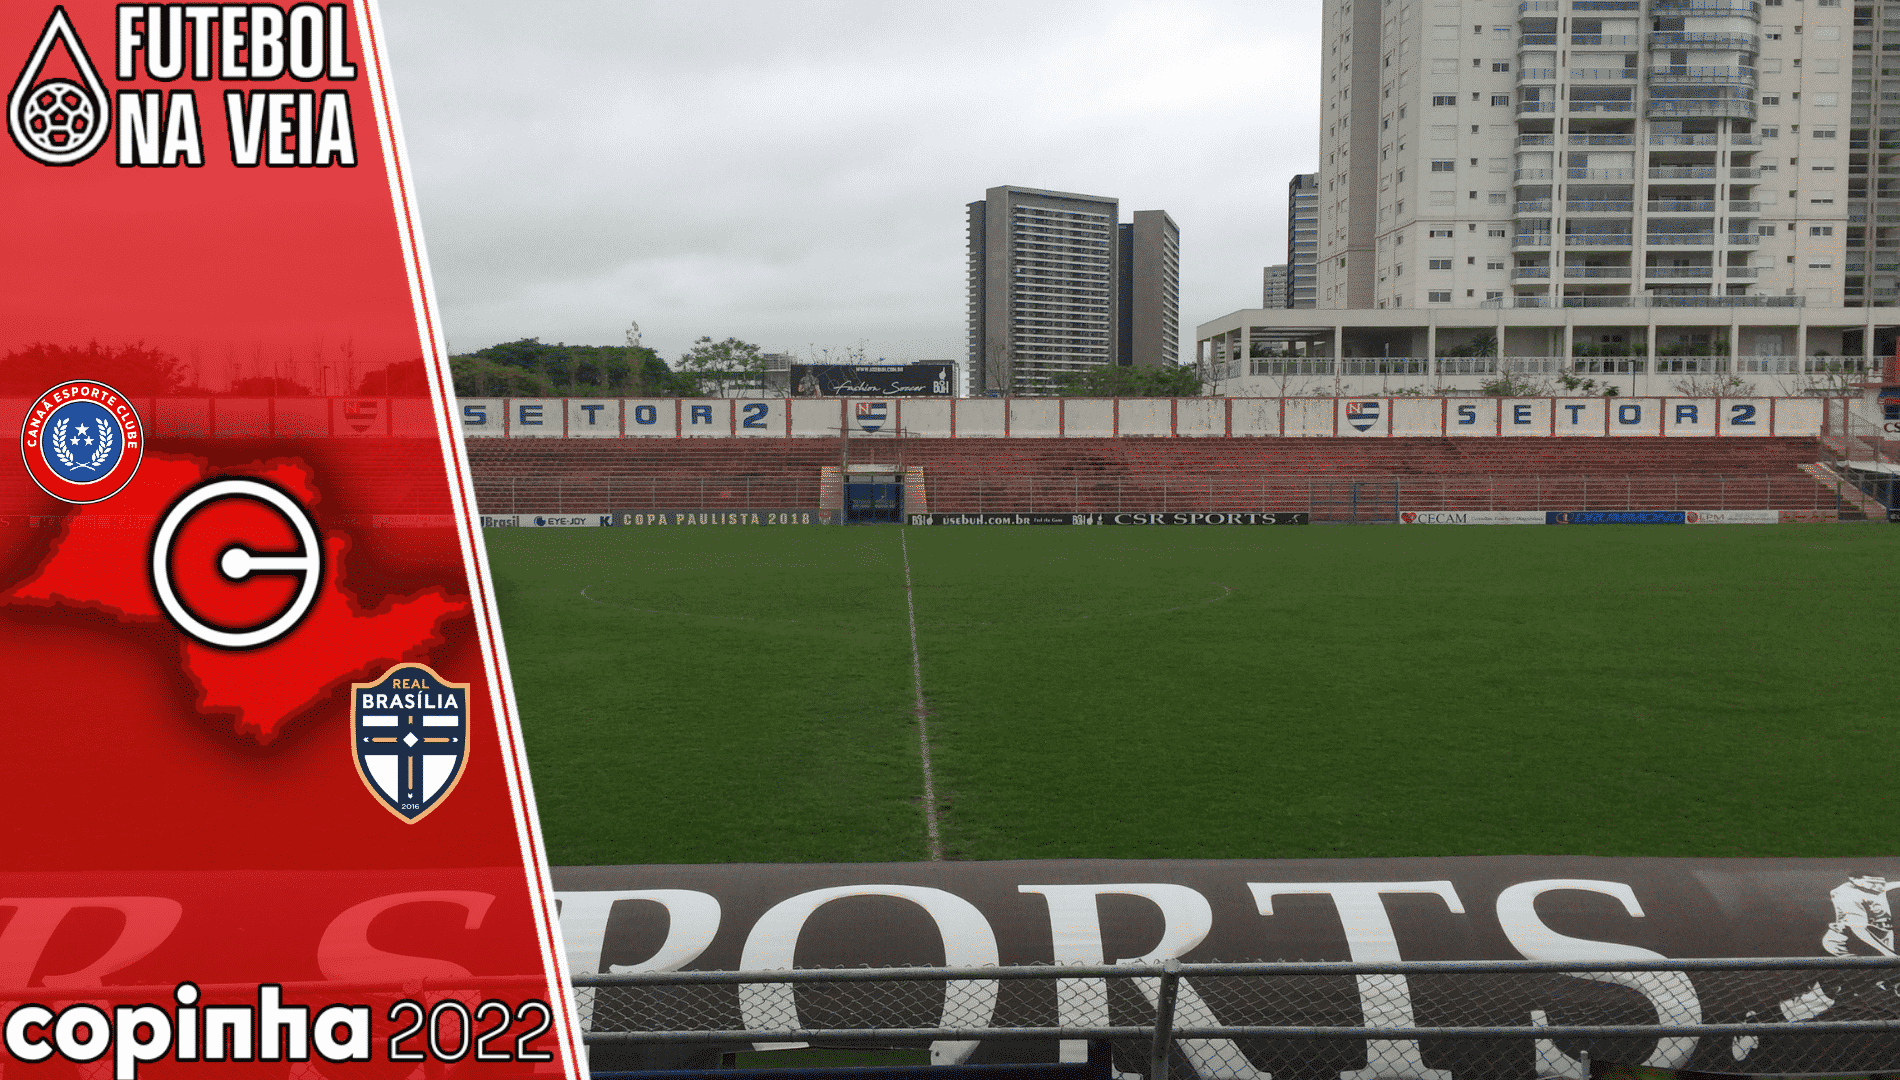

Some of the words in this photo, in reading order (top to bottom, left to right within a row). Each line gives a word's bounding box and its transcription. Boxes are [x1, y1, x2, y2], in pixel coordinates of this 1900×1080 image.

[463, 404, 714, 426] SETOR
[742, 402, 770, 429] 2
[1457, 404, 1699, 425] SETOR
[1730, 404, 1757, 426] 2
[485, 515, 520, 528] Brasil
[547, 517, 587, 525] EYE-JOY
[623, 514, 668, 526] COPA
[676, 513, 760, 526] PAULISTA
[768, 513, 811, 525] 2018
[1113, 513, 1166, 525] CSR
[1173, 513, 1277, 525] SPORTS
[1417, 513, 1468, 524] CECAM
